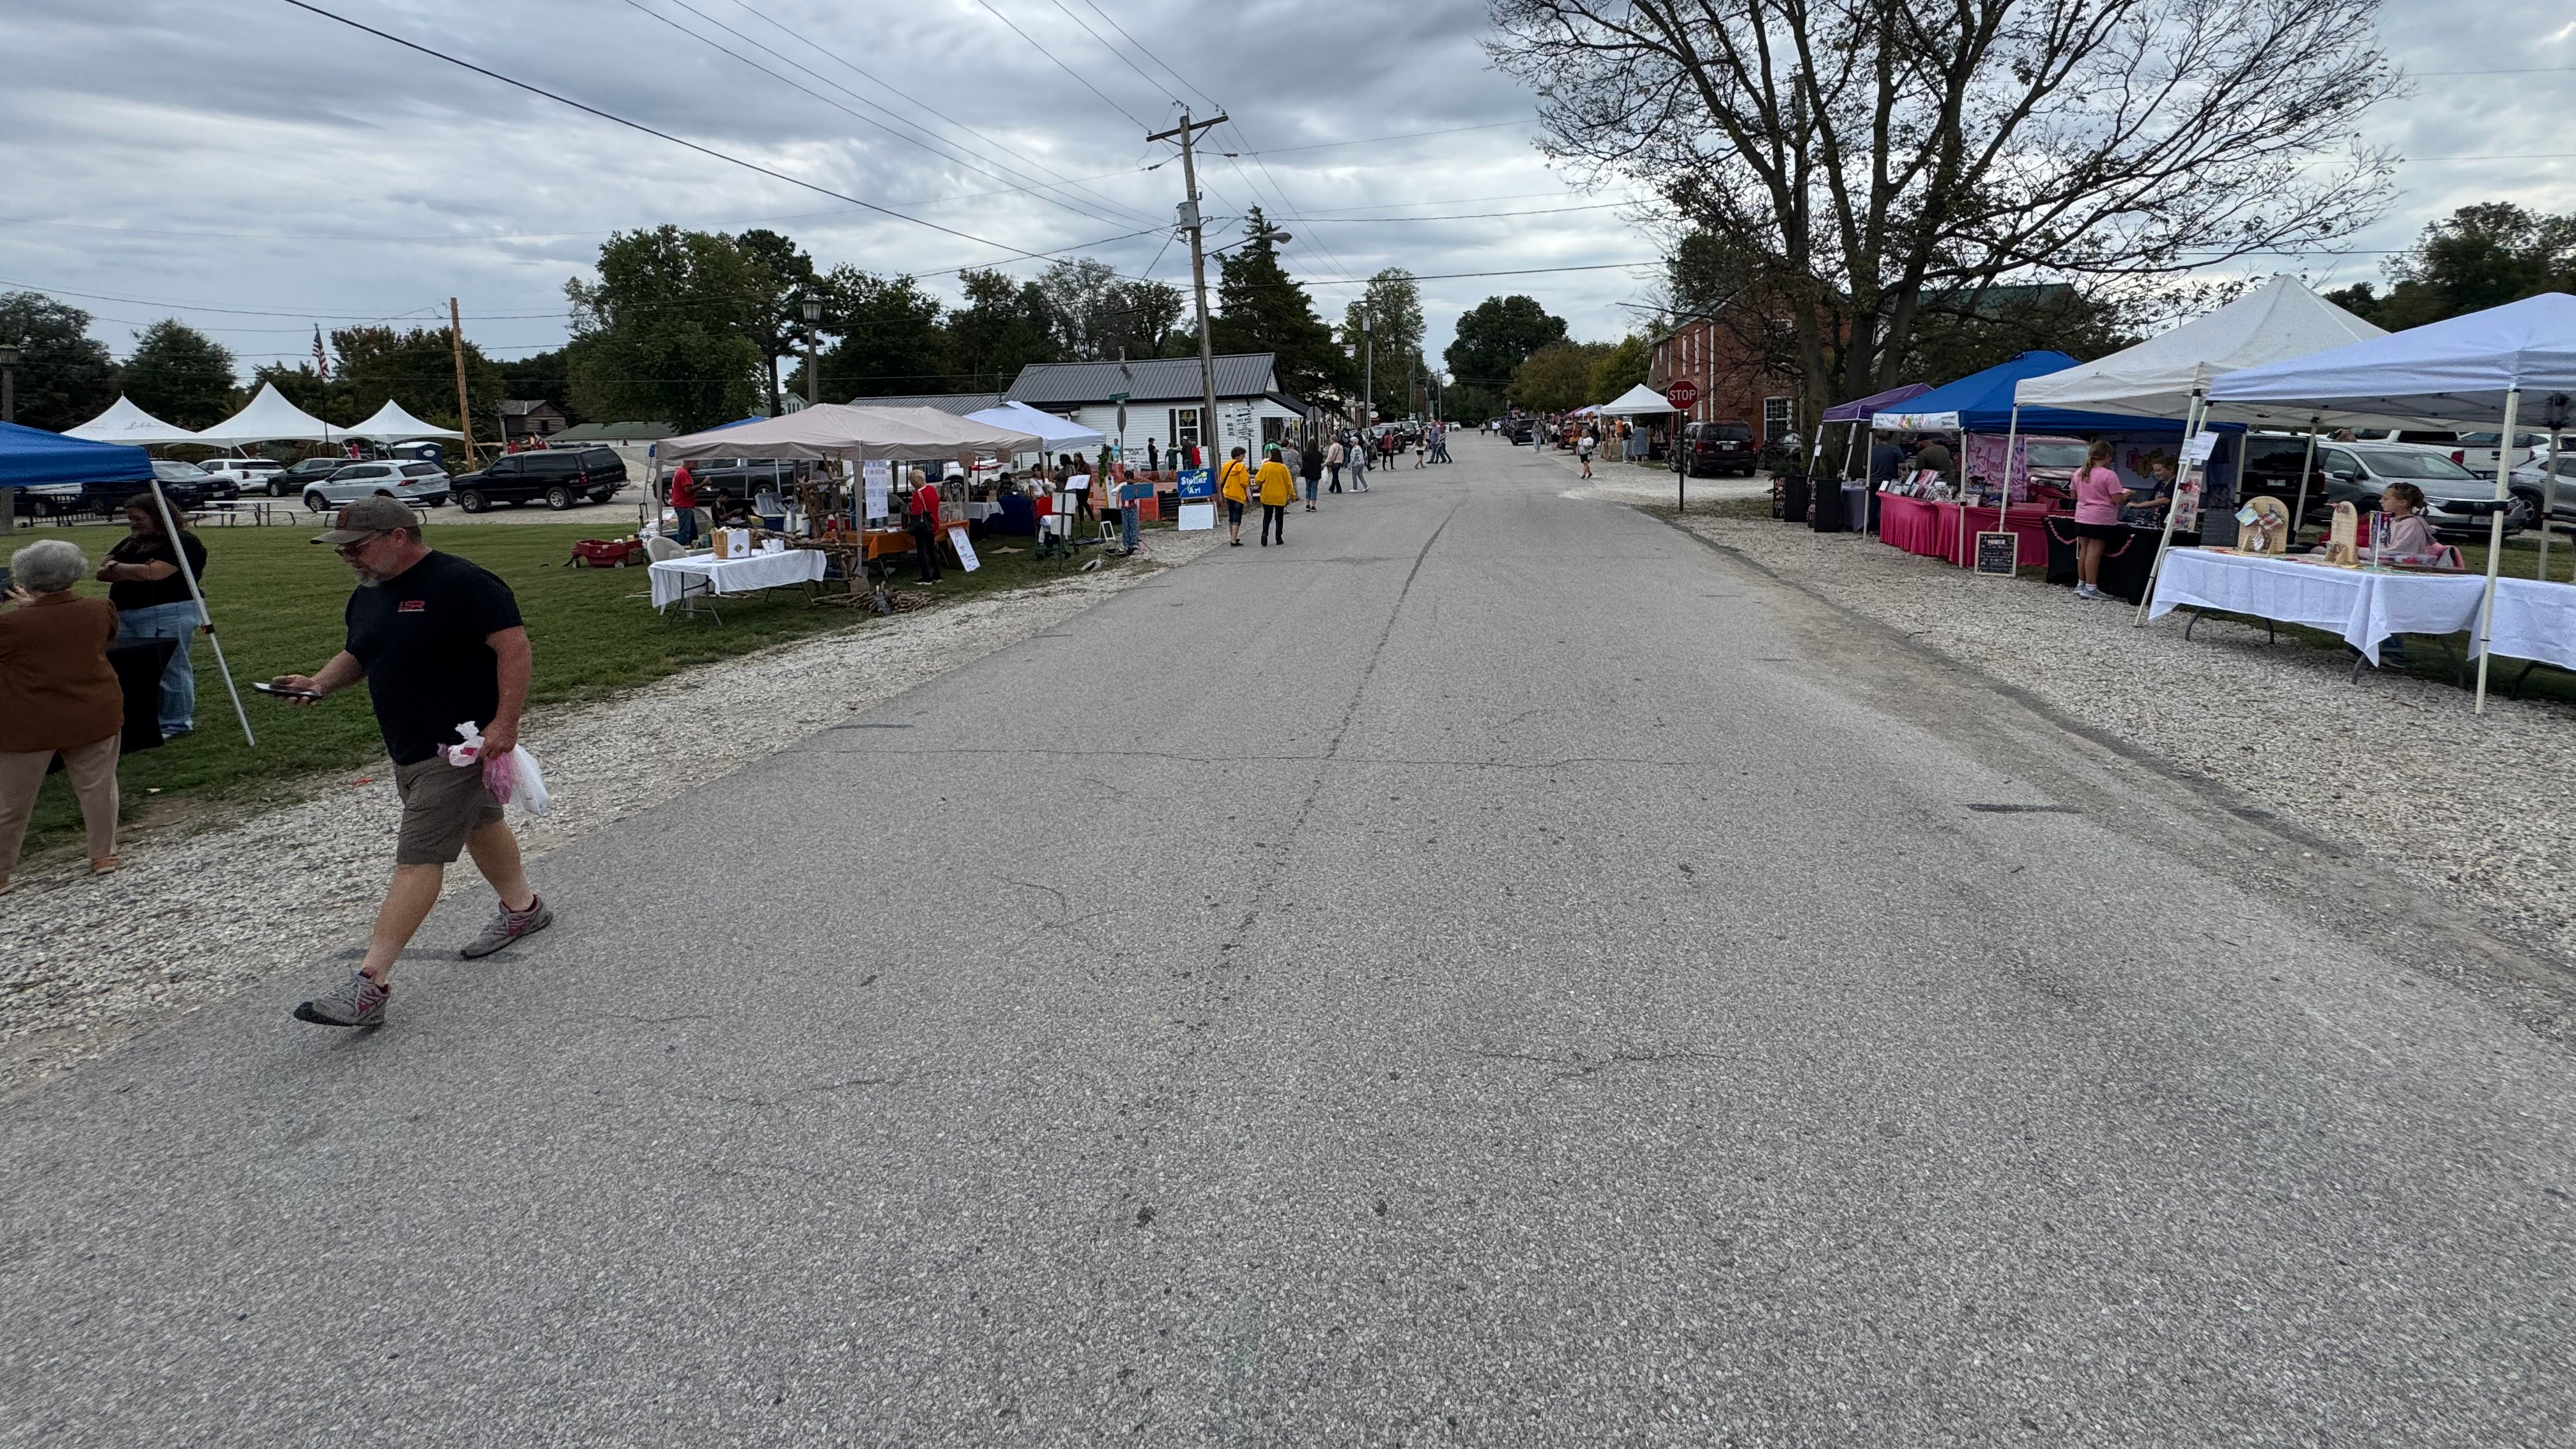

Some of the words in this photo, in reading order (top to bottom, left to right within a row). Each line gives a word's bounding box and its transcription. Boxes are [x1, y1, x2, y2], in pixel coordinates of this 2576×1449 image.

[1669, 389, 1696, 401] STOP
[1181, 475, 1208, 486] Stellar
[1188, 486, 1201, 494] Art
